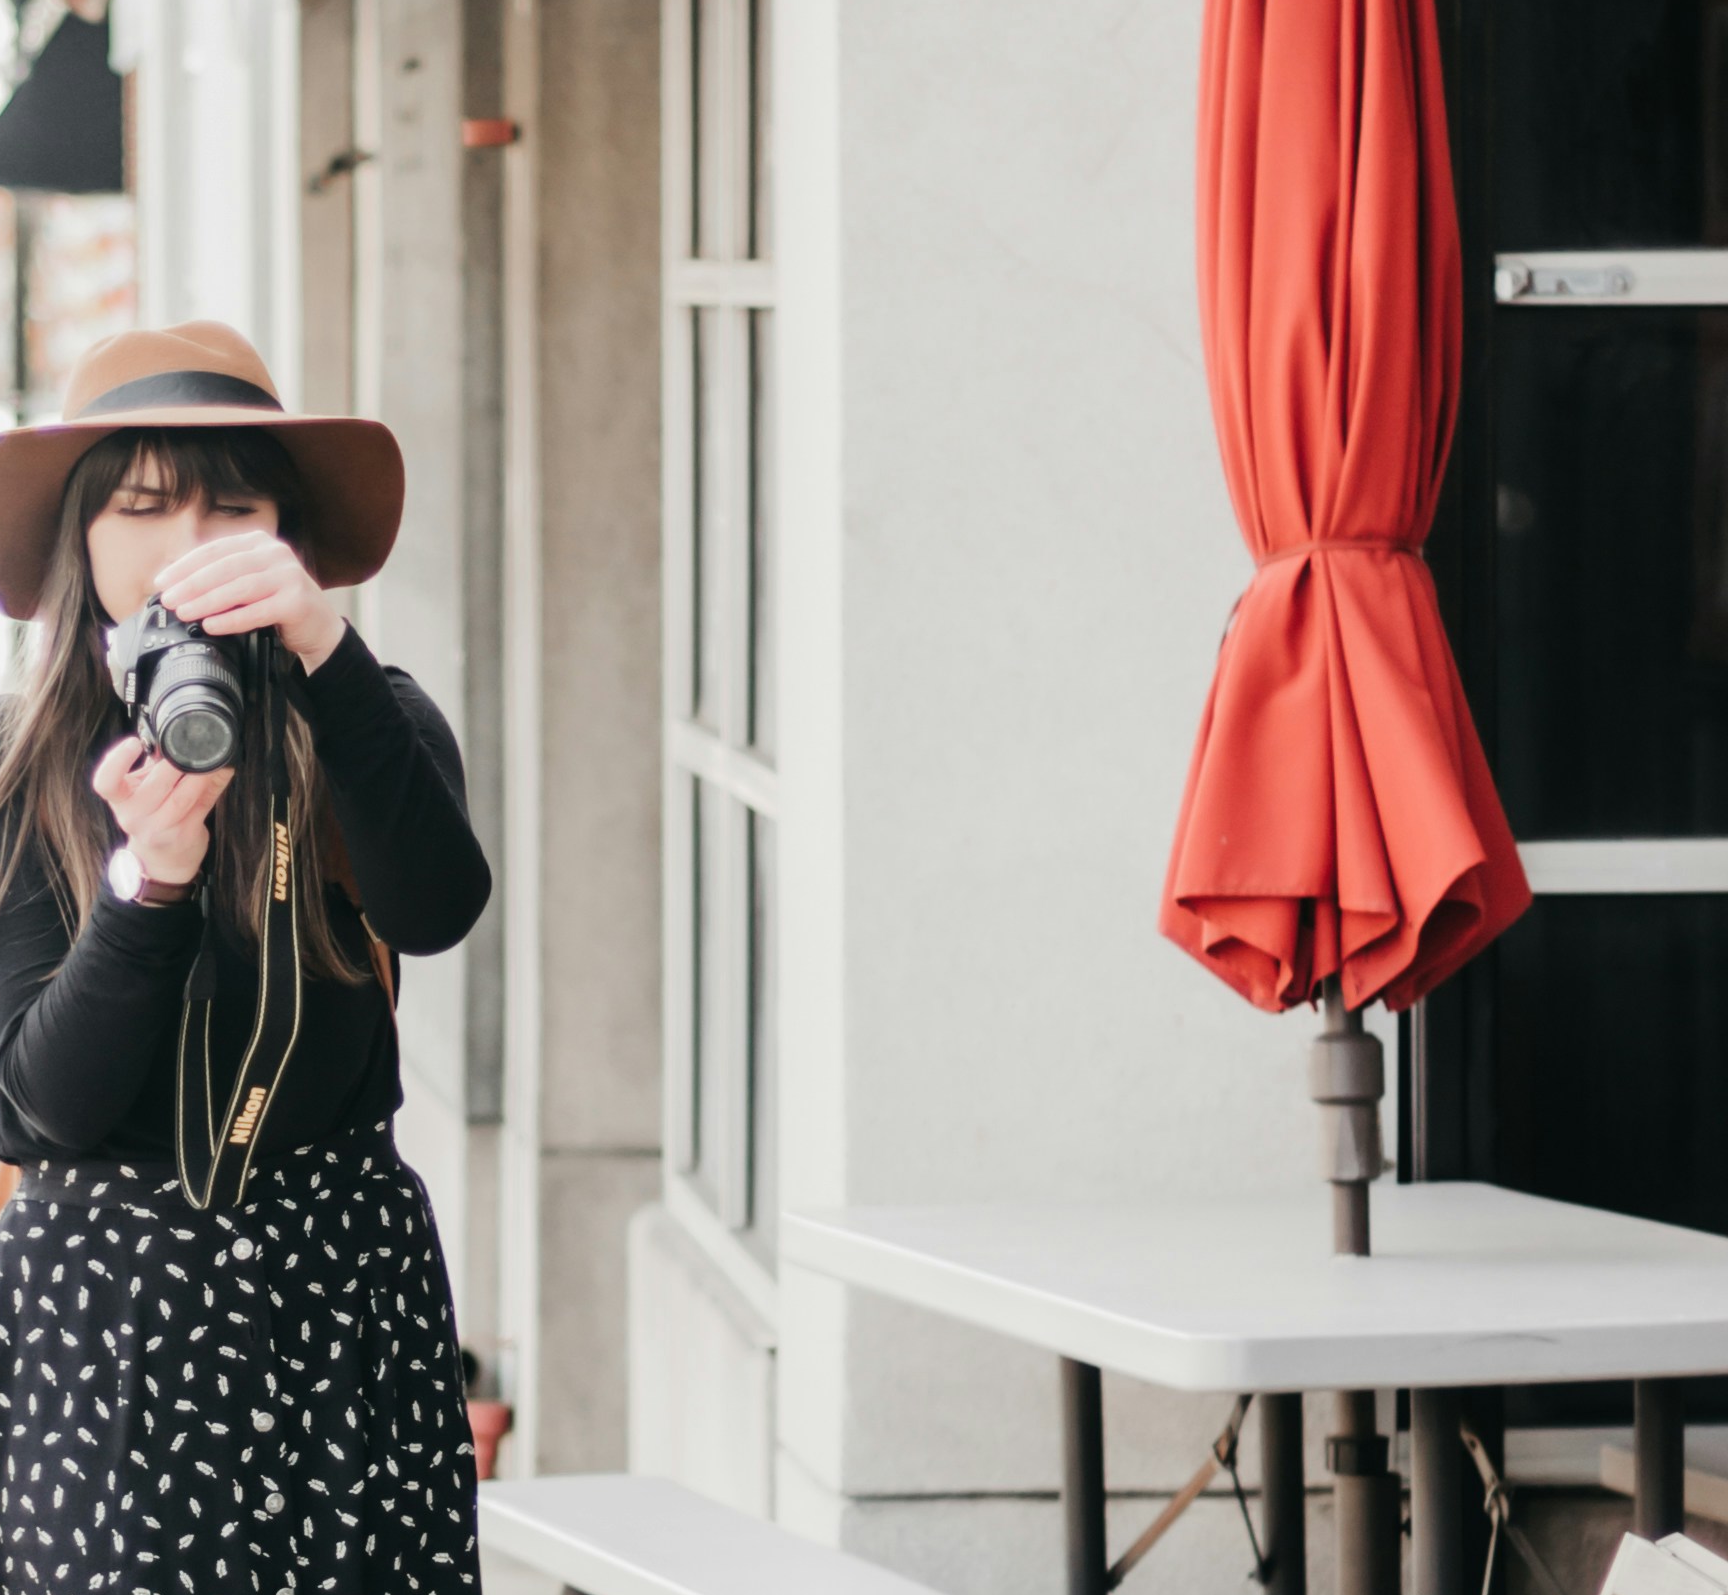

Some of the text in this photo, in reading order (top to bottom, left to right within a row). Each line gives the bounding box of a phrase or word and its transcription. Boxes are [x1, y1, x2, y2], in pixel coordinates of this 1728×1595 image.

[125, 672, 136, 703] Nikon
[274, 822, 288, 901] Nikon
[229, 1087, 267, 1144] Nikon
